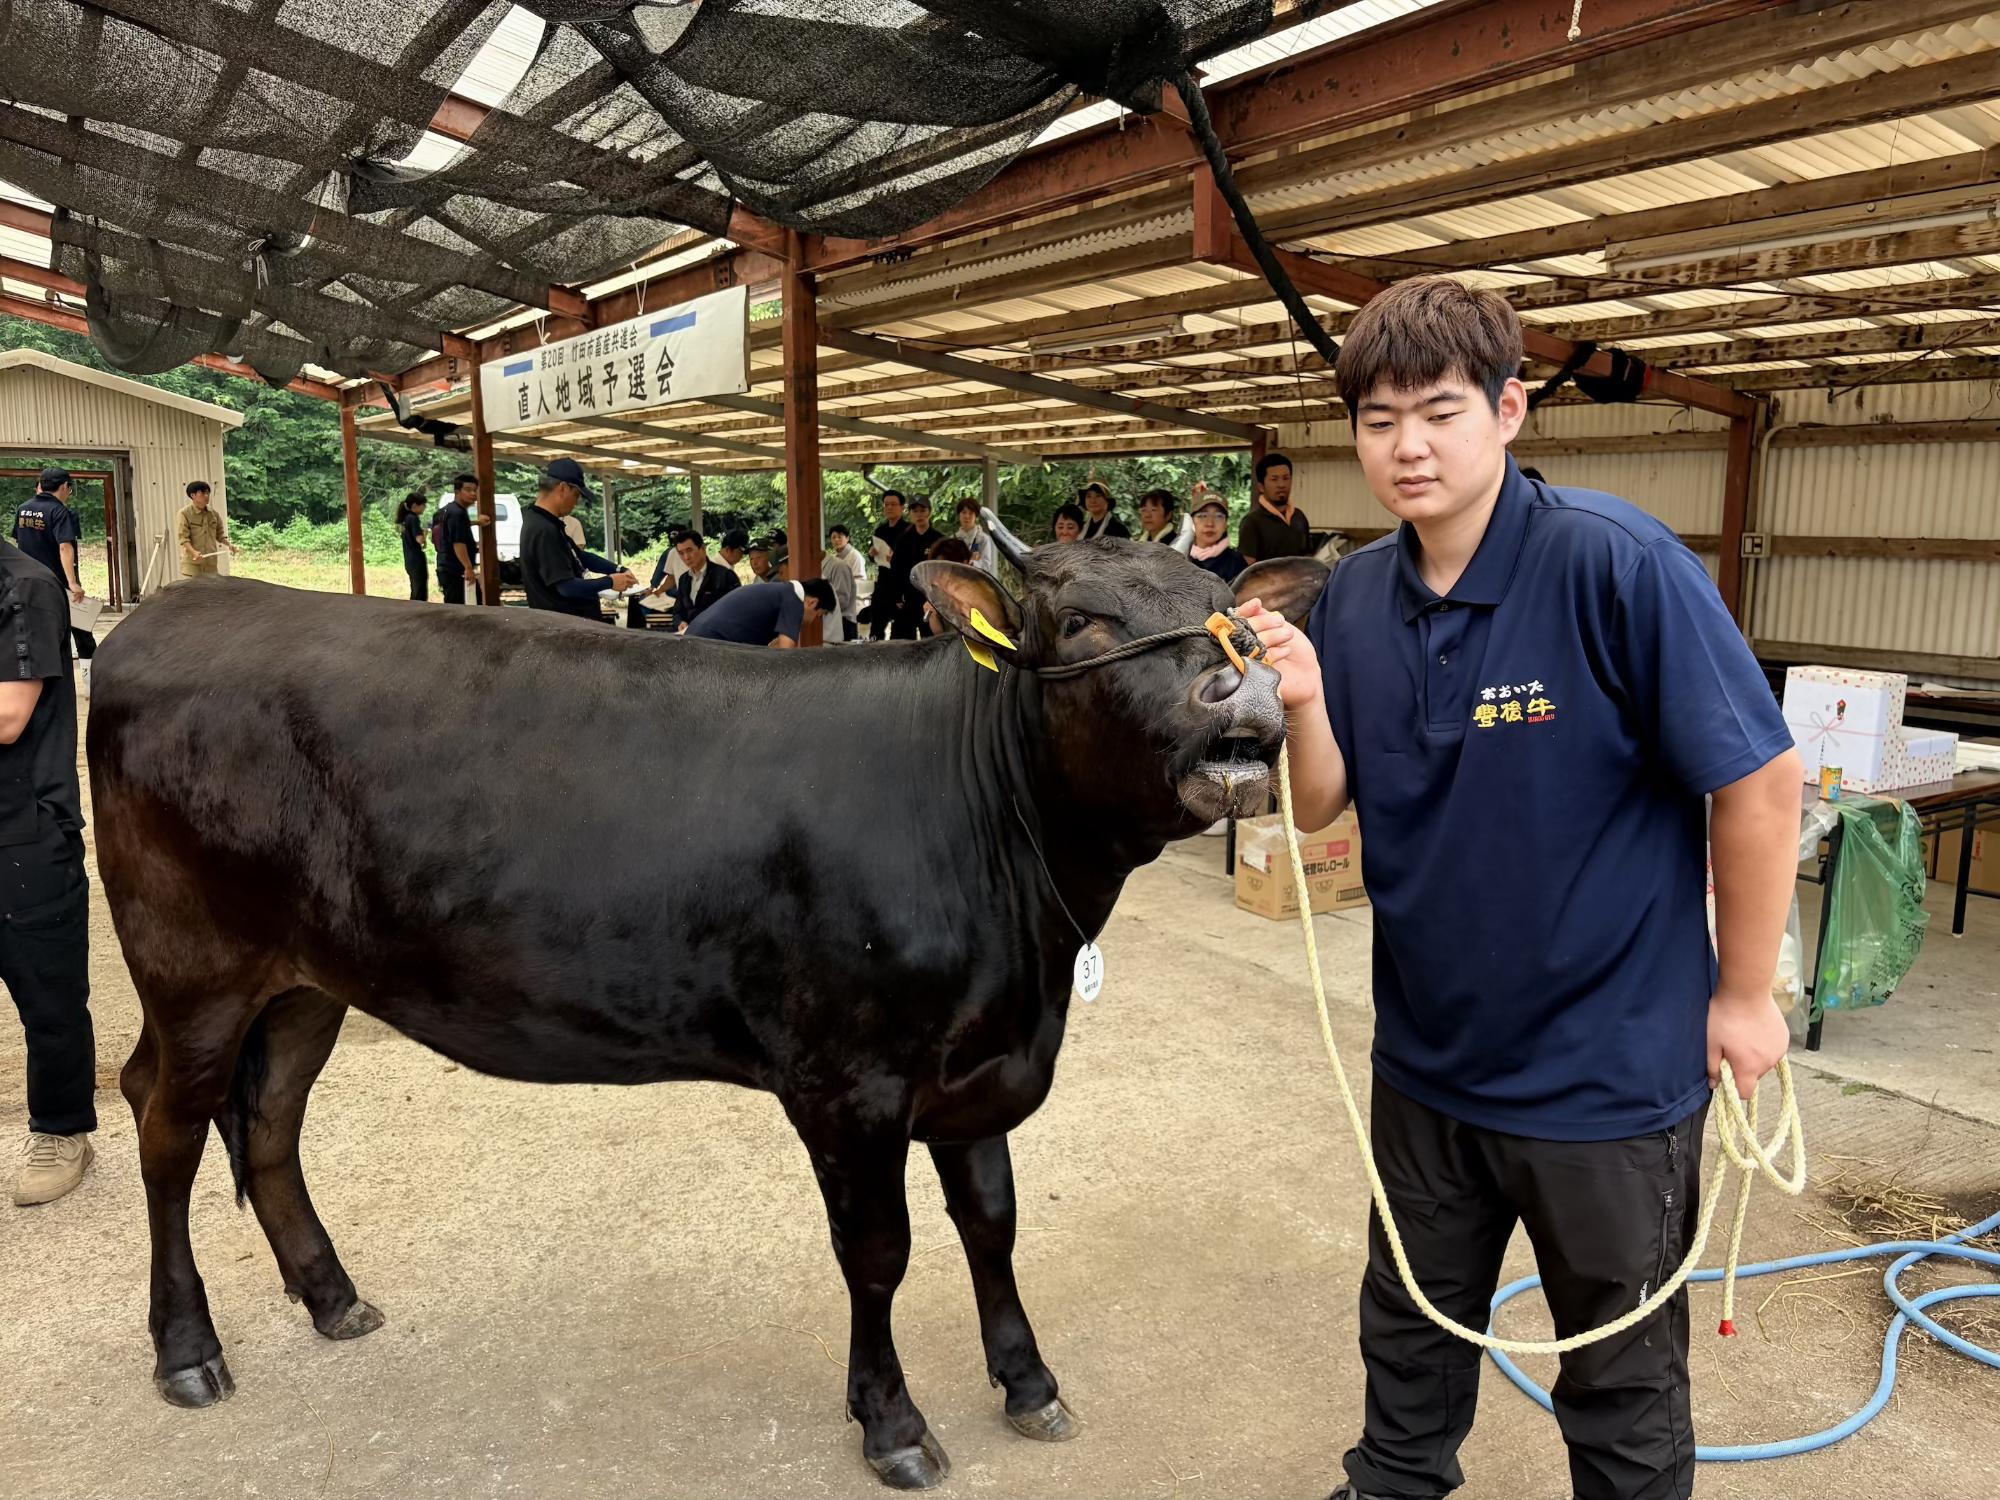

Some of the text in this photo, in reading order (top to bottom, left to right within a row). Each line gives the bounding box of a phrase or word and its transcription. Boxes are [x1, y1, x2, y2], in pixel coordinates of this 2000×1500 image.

[541, 346, 564, 370] 第20回
[518, 346, 675, 421] 直入地域予選会
[1480, 680, 1545, 701] おおいた
[1473, 698, 1557, 728] 豊後牛
[1083, 955, 1097, 979] 37
